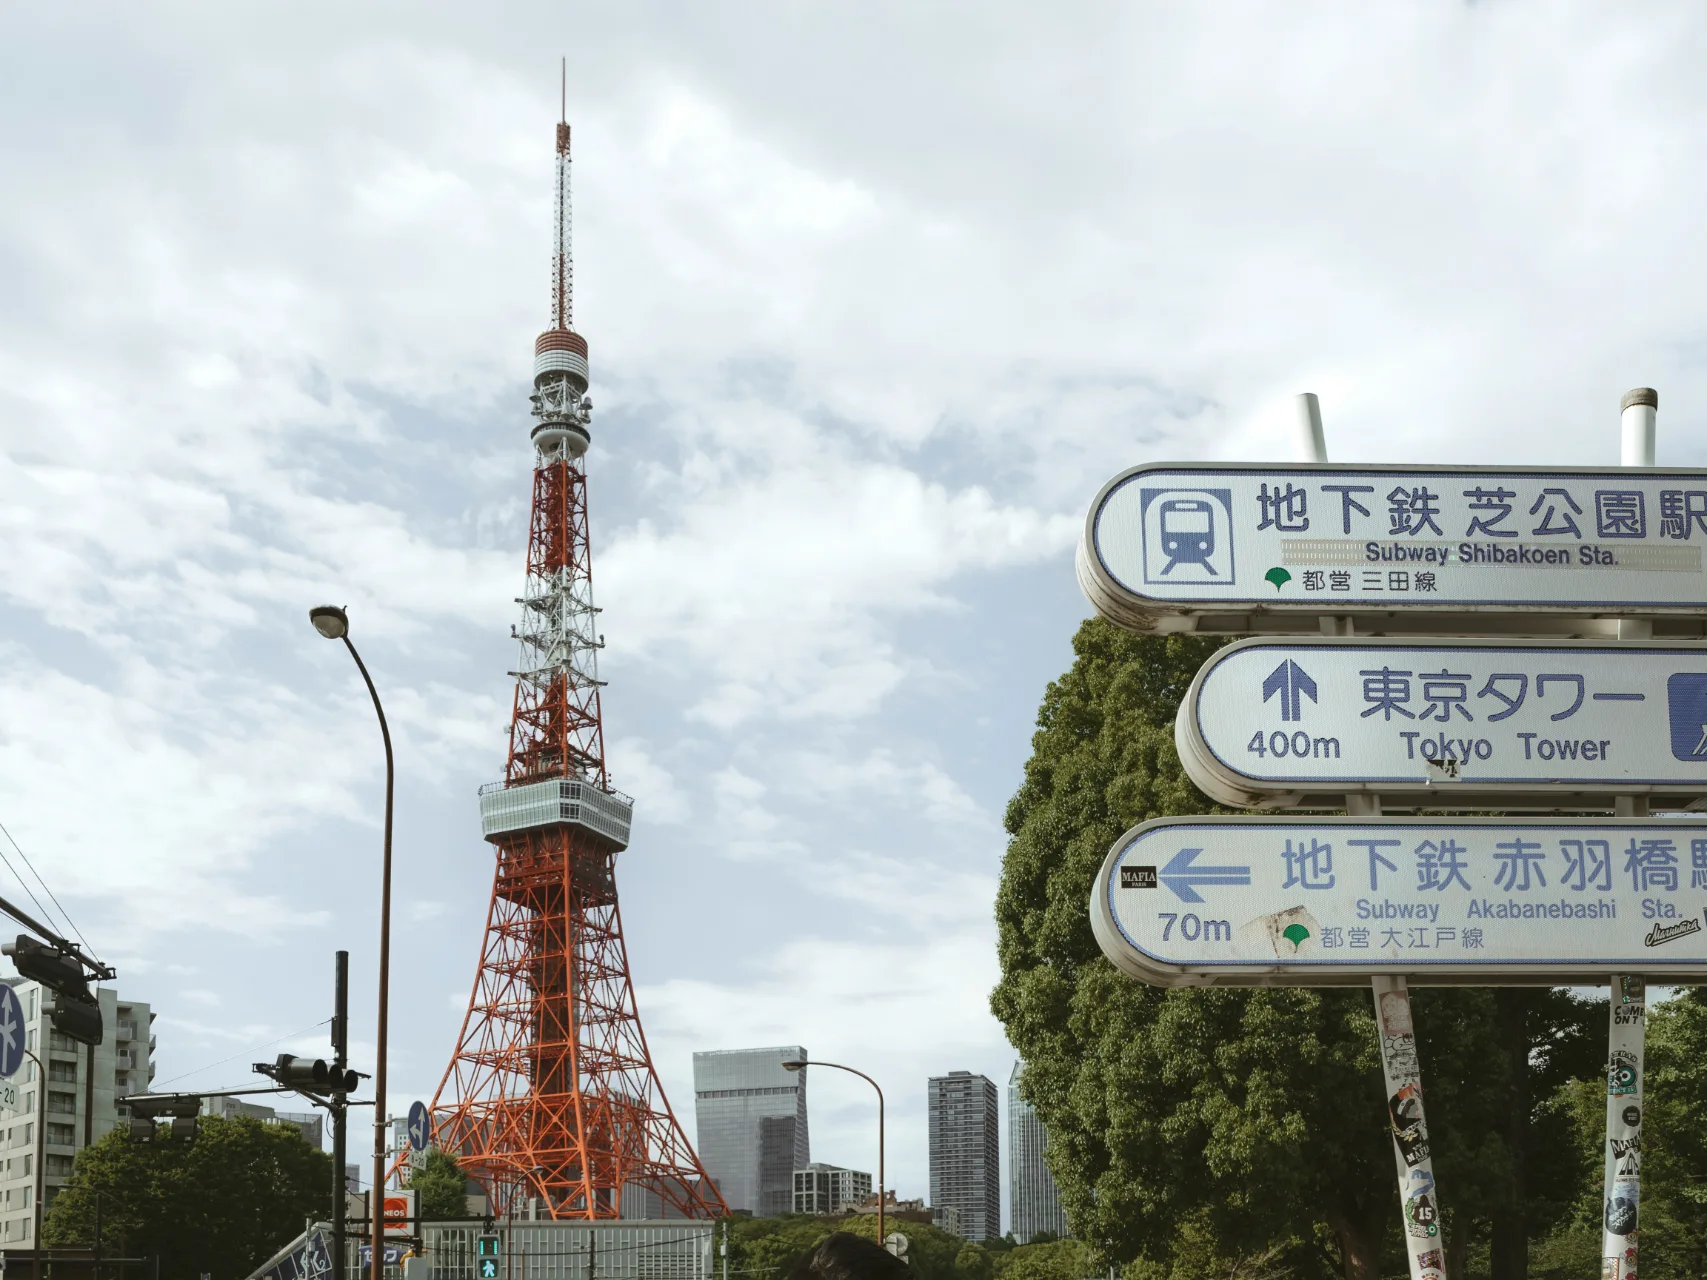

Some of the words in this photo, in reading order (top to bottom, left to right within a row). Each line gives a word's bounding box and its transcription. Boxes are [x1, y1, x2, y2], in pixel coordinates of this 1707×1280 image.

[1256, 483, 1443, 536] 地下鉄
[1463, 486, 1707, 540] 芝公園駅
[1366, 542, 1449, 566] Subway
[1458, 543, 1570, 565] Shibakoen
[1579, 545, 1619, 566] Sta.
[1302, 570, 1352, 592] 都営
[1361, 571, 1438, 592] 三田線
[1359, 666, 1646, 722] 東京タワー
[1247, 730, 1341, 759] 400m
[1399, 732, 1493, 766] Tokyo
[1516, 732, 1611, 761] Tower
[1122, 871, 1156, 881] MAFIA
[1281, 838, 1469, 892] 地下鉄
[1356, 898, 1440, 921] Subway
[1466, 898, 1617, 920] Akabanebashi
[1641, 898, 1683, 919] Sta.
[1158, 912, 1232, 942] 70m
[1320, 927, 1371, 949] 都営
[1380, 926, 1485, 949] 大江戸線
[384, 1209, 405, 1217] NEOS
[1418, 1207, 1432, 1220] 15
